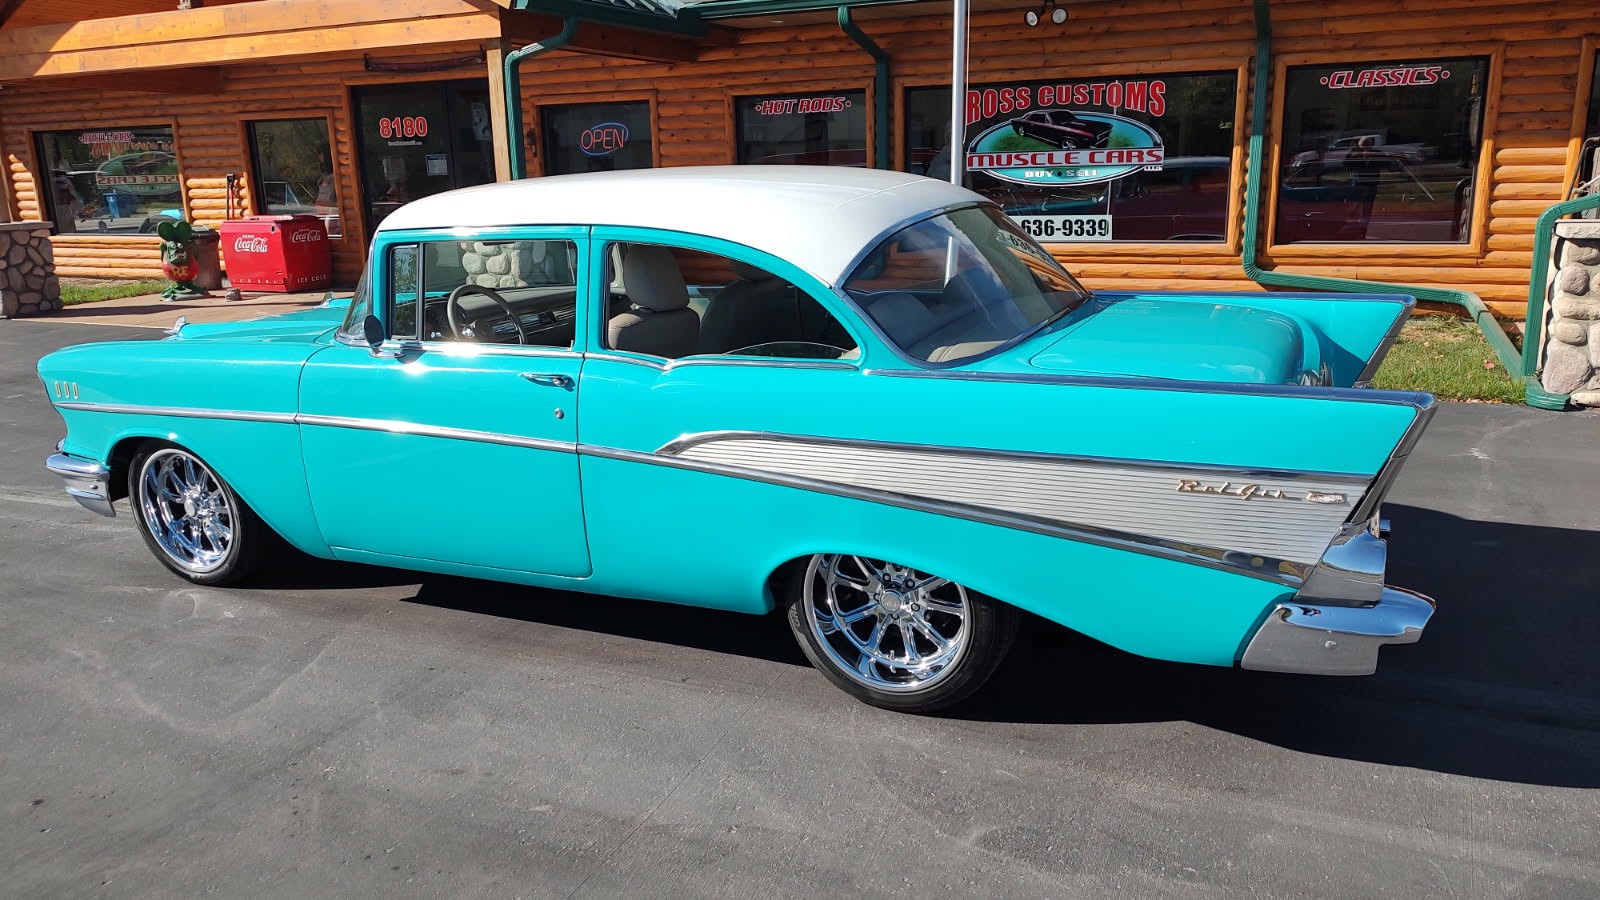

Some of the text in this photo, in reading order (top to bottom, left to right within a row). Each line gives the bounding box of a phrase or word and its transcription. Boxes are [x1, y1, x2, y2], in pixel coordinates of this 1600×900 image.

[1328, 66, 1442, 89] CLASSICS
[760, 96, 846, 115] HOT RODS
[966, 80, 1166, 126] ROSS CUSTOMS
[379, 116, 428, 139] 8180
[580, 127, 626, 150] OPEN
[967, 148, 1163, 168] MUSCLE CARS
[1024, 169, 1098, 178] BUY SELL
